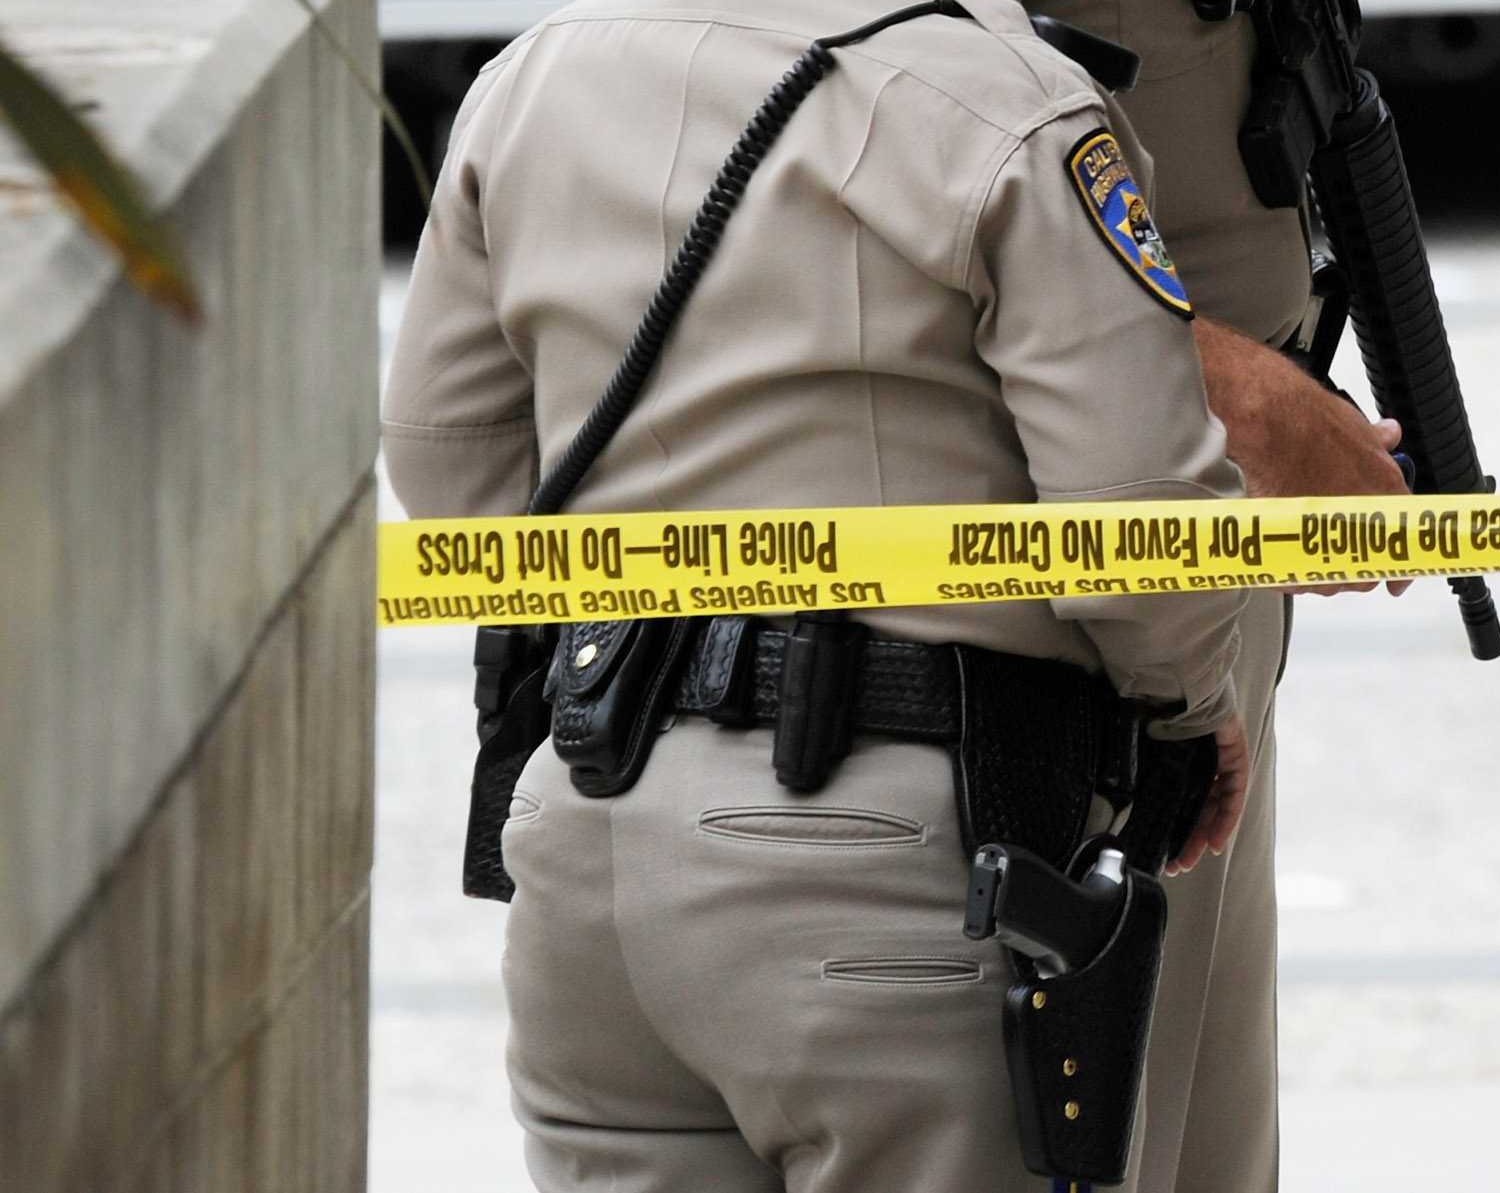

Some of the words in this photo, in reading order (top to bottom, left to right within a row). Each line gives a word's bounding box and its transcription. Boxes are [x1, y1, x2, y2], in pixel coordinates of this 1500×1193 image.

[740, 521, 838, 574] Police
[948, 521, 1050, 573] Cruzar
[1061, 519, 1105, 571] No
[1115, 517, 1199, 569] Favor
[1418, 509, 1460, 559] De
[418, 531, 505, 584] Cross
[516, 529, 571, 582] Not
[579, 588, 683, 616] Police
[690, 580, 818, 611] Angeles
[830, 581, 886, 605] Los
[937, 577, 1066, 601] Angeles
[1074, 577, 1130, 595] Los
[1137, 576, 1181, 591] De
[379, 589, 571, 623] Department
